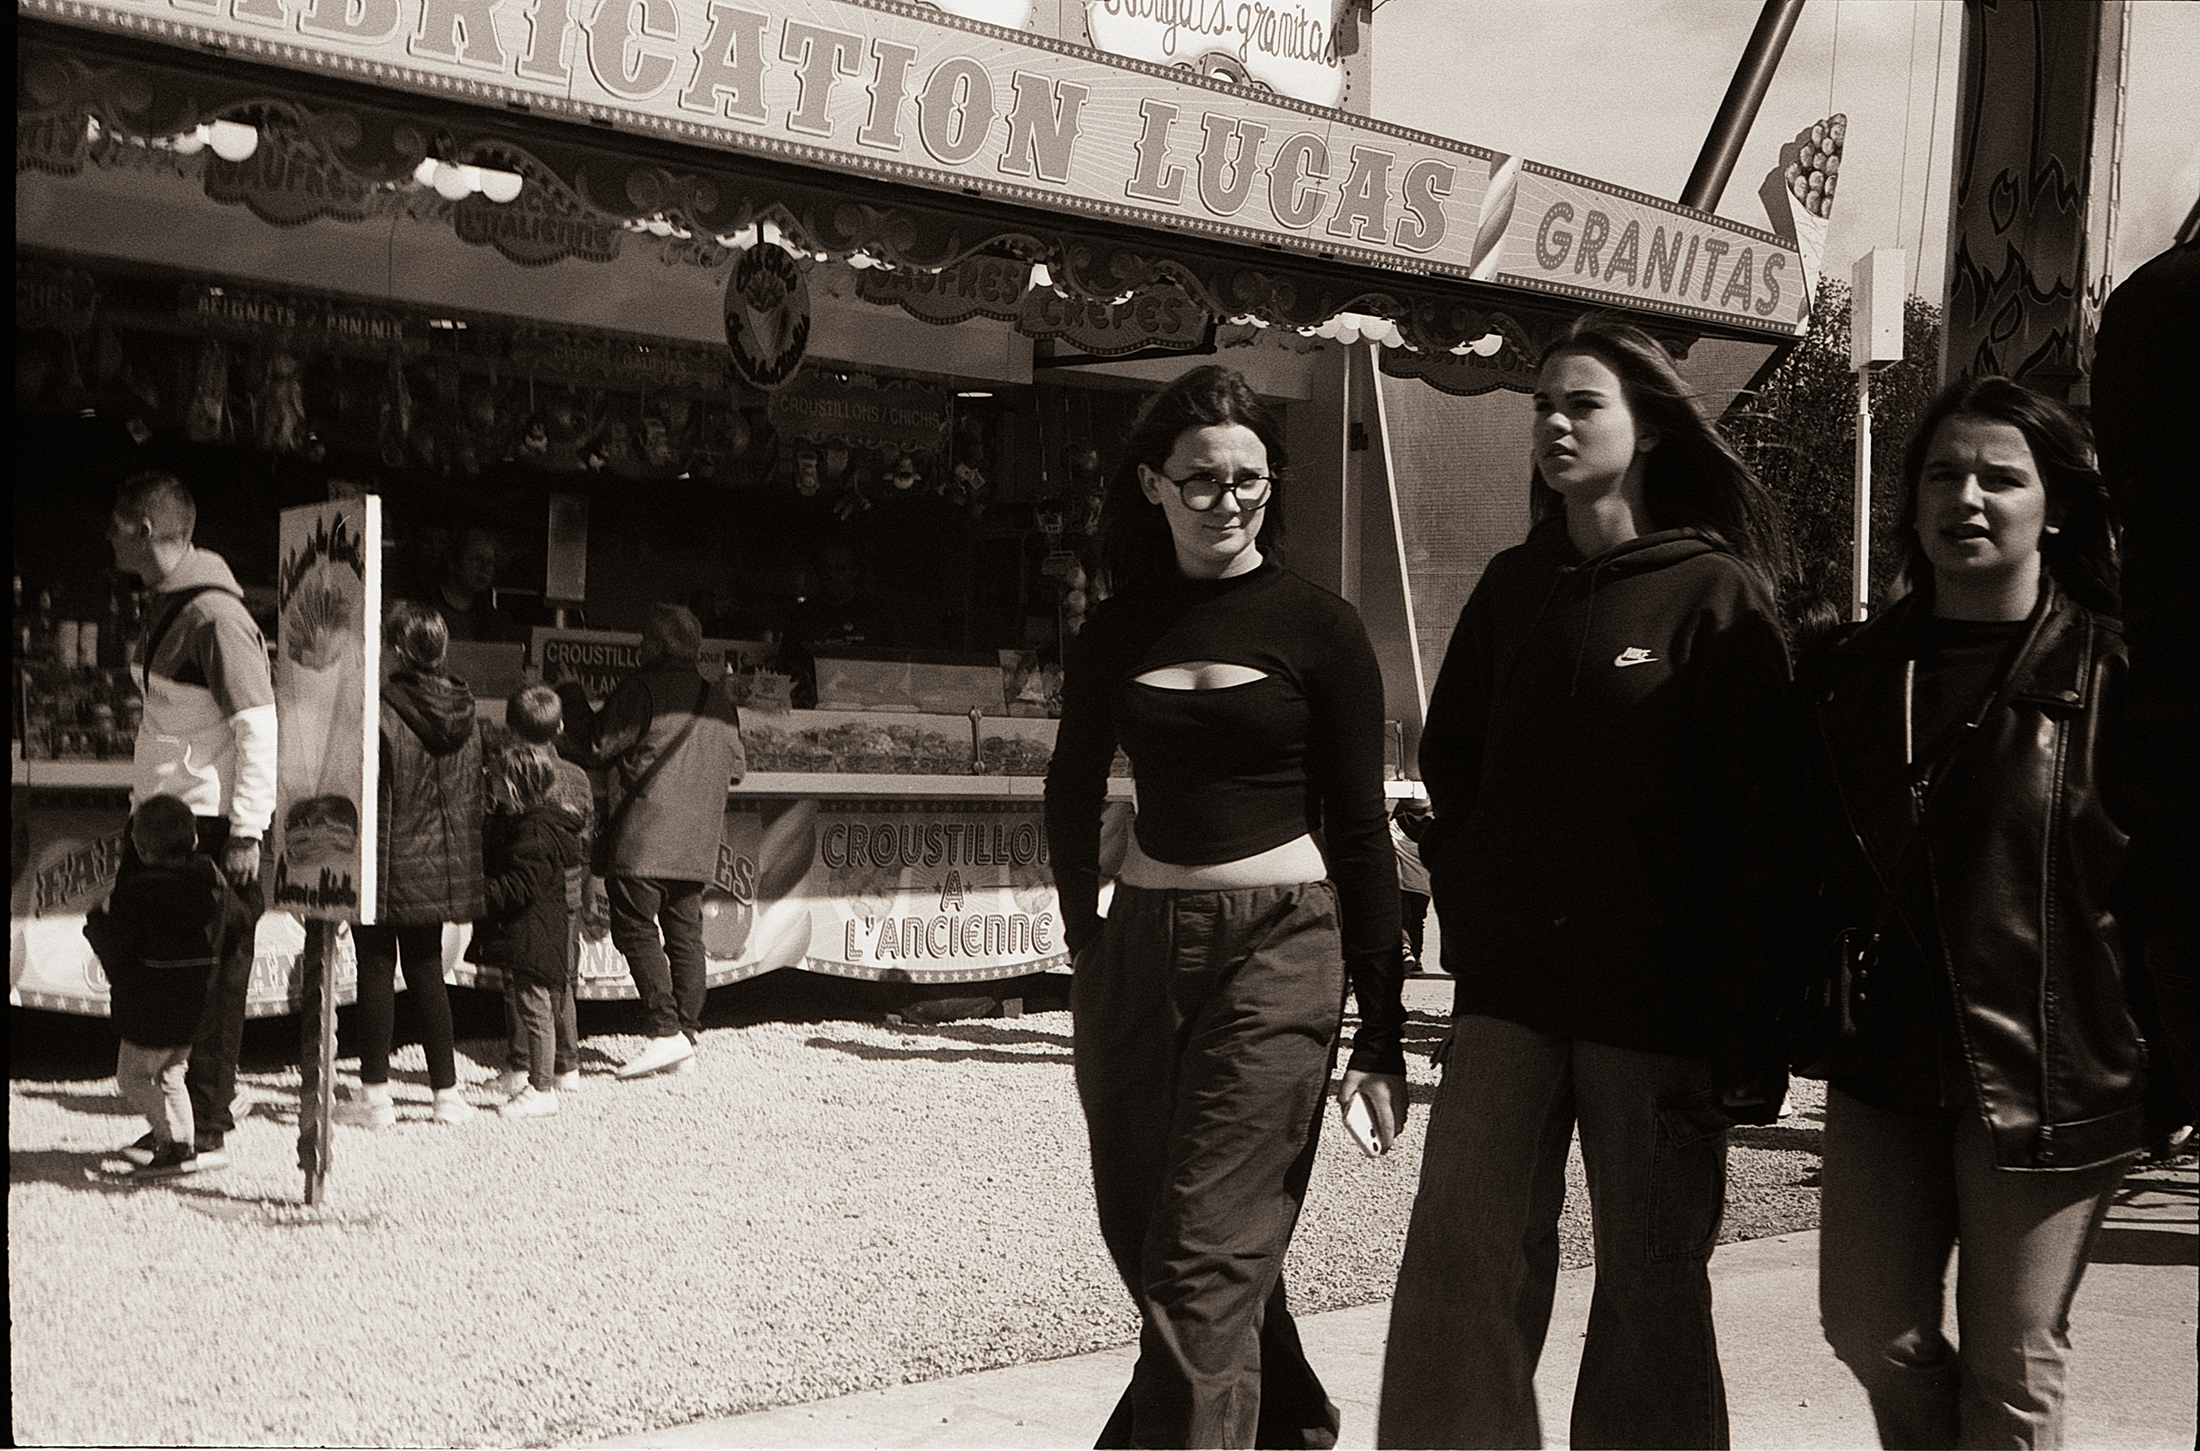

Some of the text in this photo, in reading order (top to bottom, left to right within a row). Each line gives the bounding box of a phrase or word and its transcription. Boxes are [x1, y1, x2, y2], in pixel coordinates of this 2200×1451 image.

[168, 0, 1458, 254] RICATION LUCAS
[1534, 200, 1787, 319] GRANITAS
[779, 396, 879, 424] CROUSTILLONS
[890, 408, 940, 428] CHICHIS
[940, 869, 965, 912] A
[845, 912, 1054, 962] L'ANCIENNE
